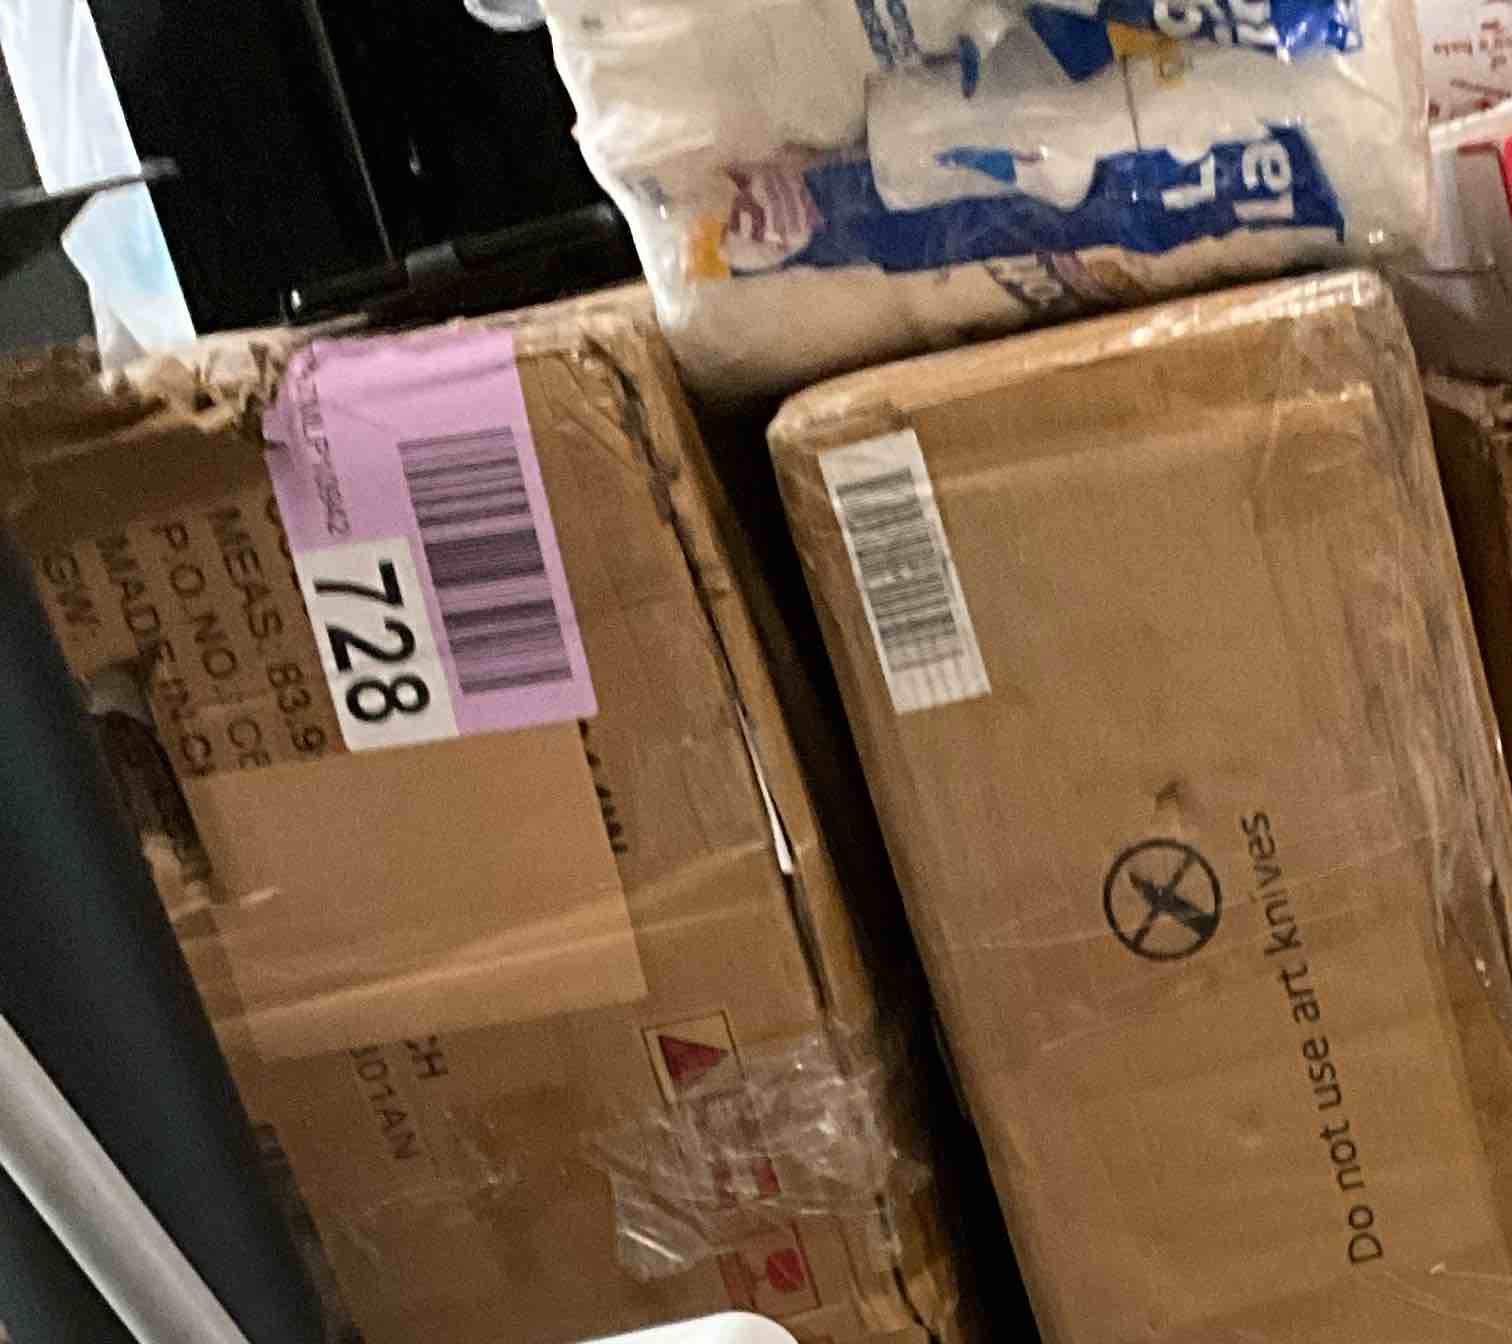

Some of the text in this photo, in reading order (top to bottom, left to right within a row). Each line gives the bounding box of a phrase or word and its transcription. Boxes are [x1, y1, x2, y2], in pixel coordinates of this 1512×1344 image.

[311, 558, 435, 731] 728
[1242, 810, 1383, 1267] Do not use art knives
